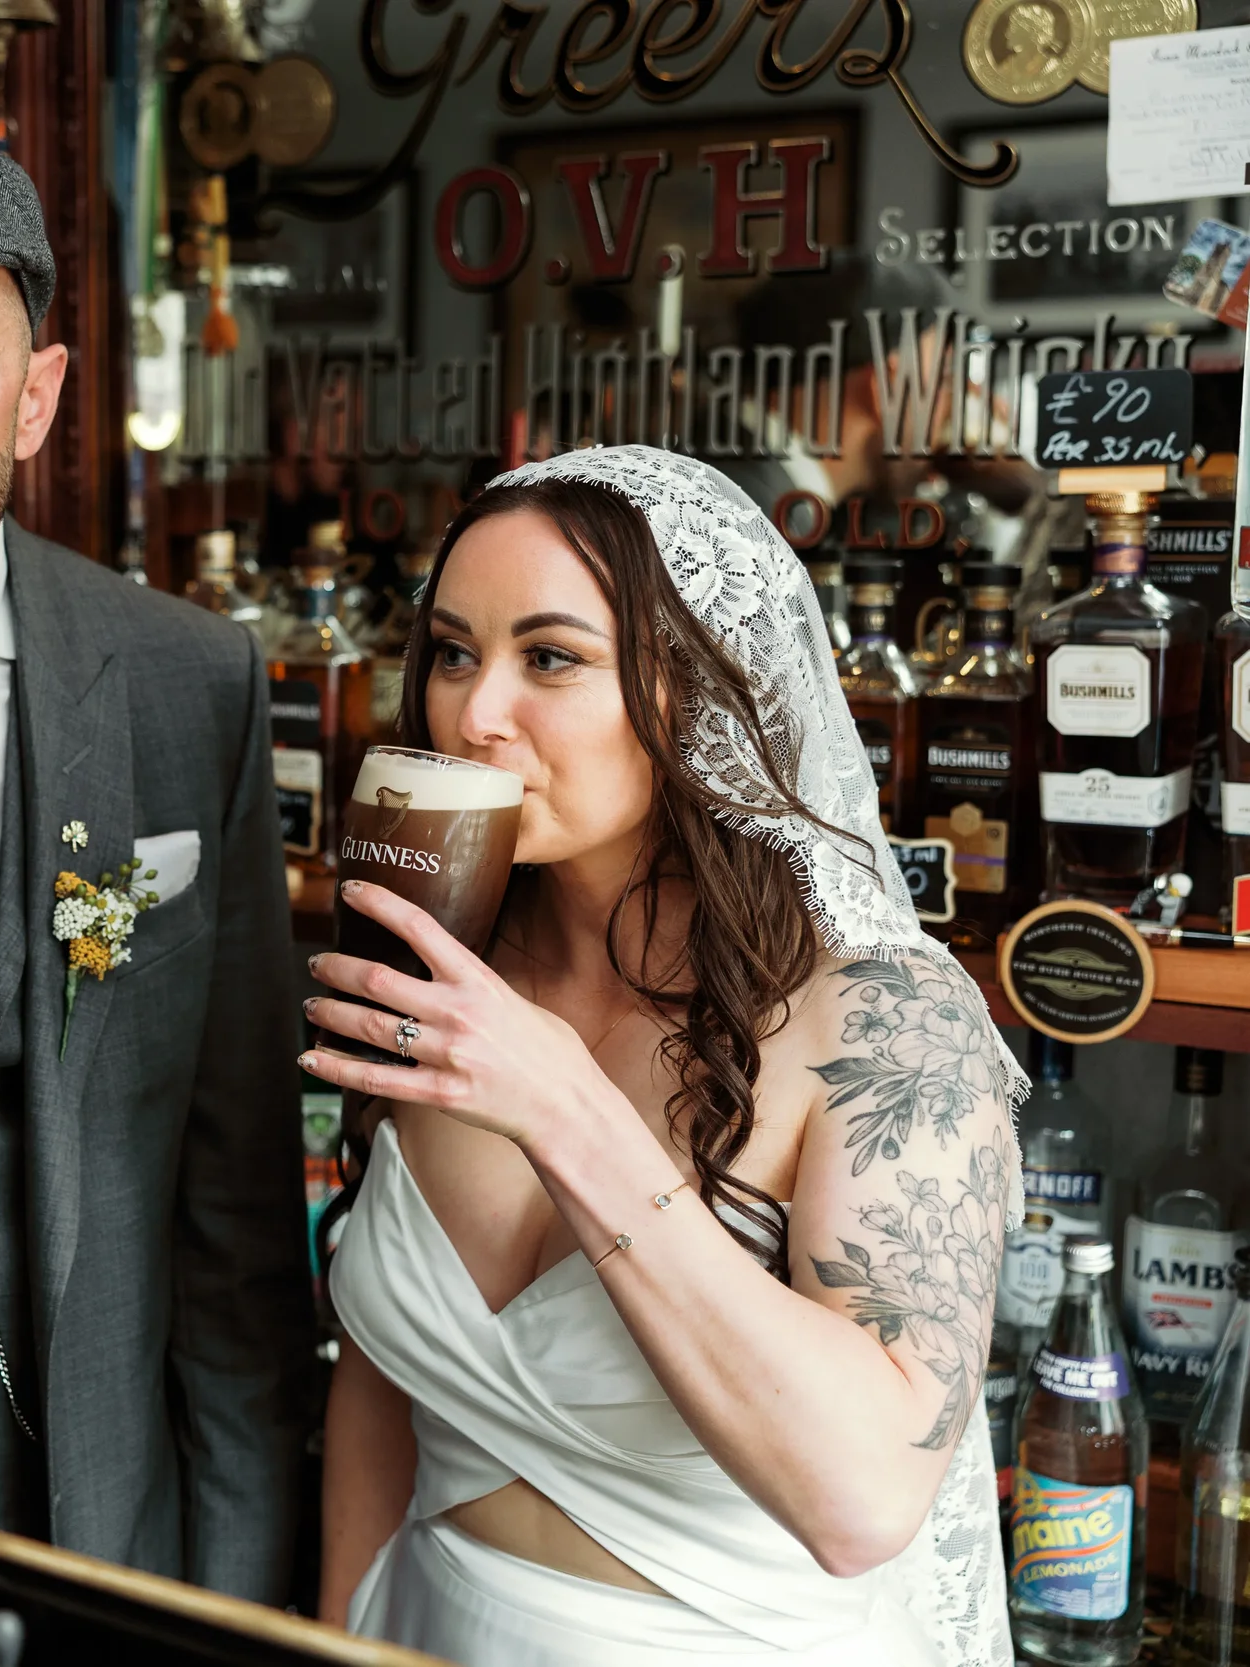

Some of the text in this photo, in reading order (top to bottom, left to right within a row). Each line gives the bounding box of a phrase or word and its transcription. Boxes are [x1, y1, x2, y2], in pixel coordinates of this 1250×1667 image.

[1046, 372, 1151, 425] £90
[1148, 530, 1227, 552] SHMILLS
[1059, 682, 1136, 700] BUSHMILLS
[928, 746, 1011, 770] BUSHMILLS
[1085, 776, 1110, 793] 25
[340, 835, 442, 875] GUINNESS
[1024, 1172, 1095, 1198] RNOFF
[1012, 1506, 1114, 1559] maine
[1023, 1551, 1118, 1583] LEMONADE
